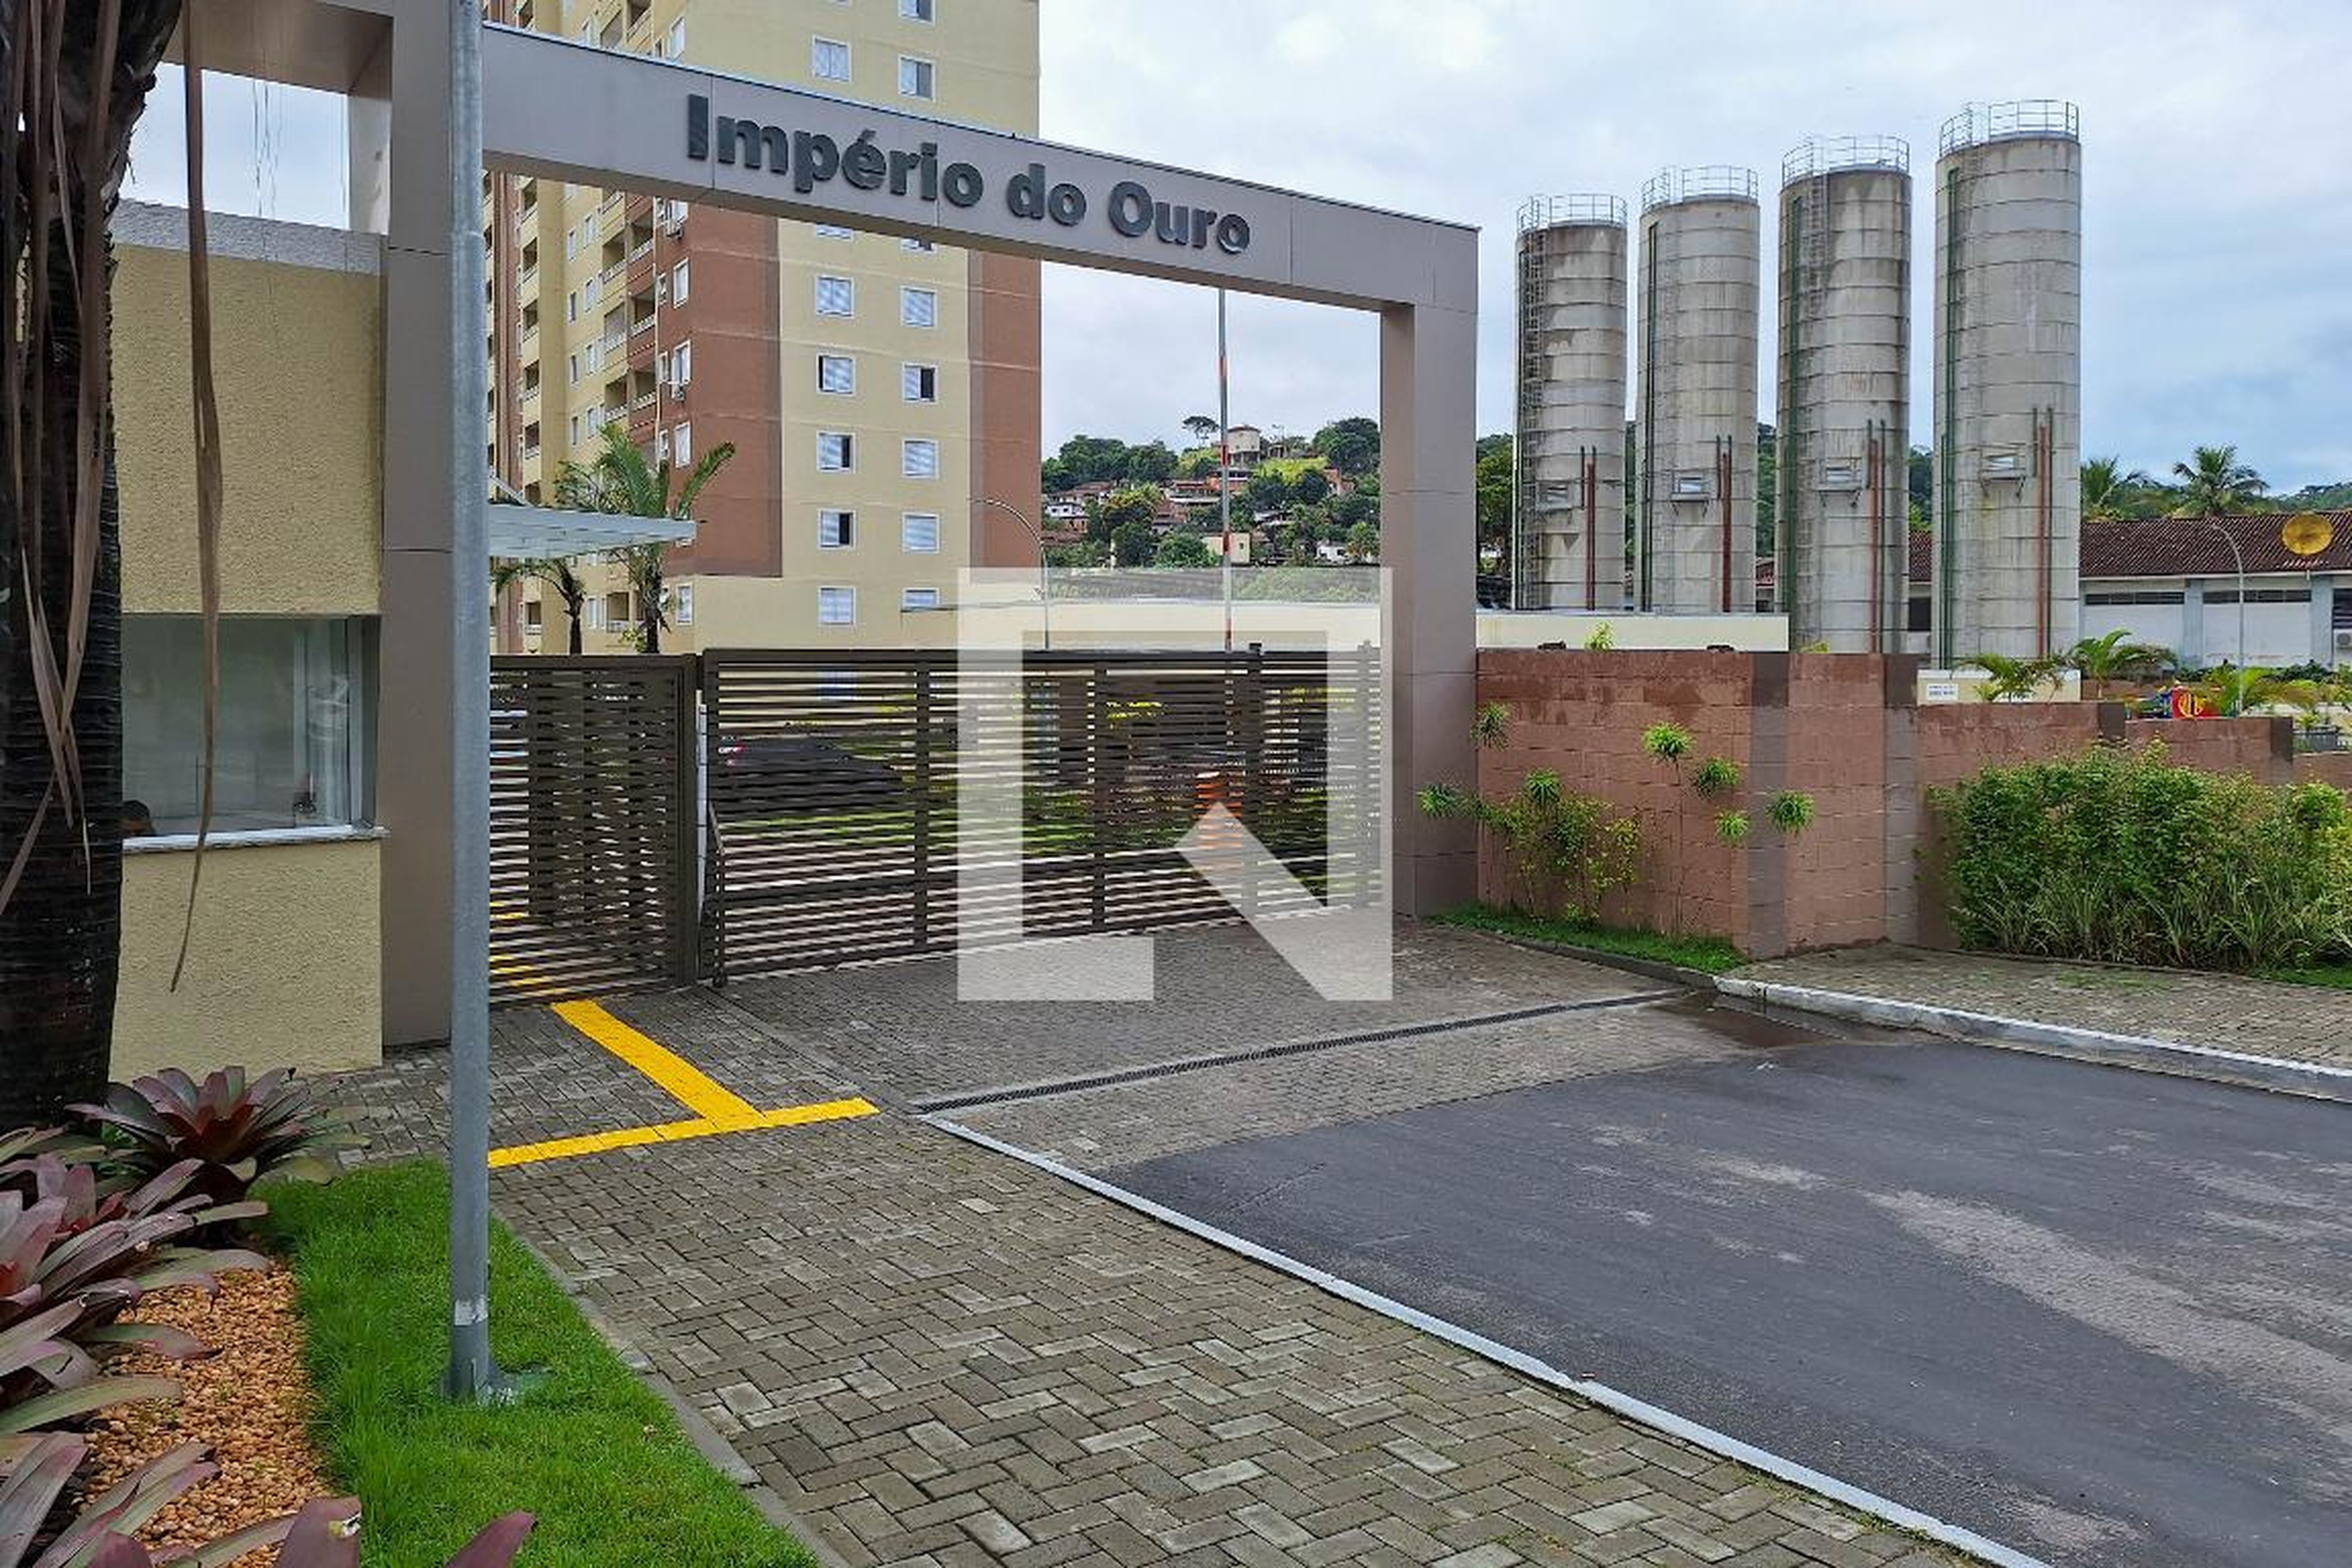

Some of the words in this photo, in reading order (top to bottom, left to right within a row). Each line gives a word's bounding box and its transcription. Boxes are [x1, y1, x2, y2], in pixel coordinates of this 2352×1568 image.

[688, 94, 984, 208] Império
[1007, 163, 1087, 226] do
[1108, 181, 1250, 254] Ouro
